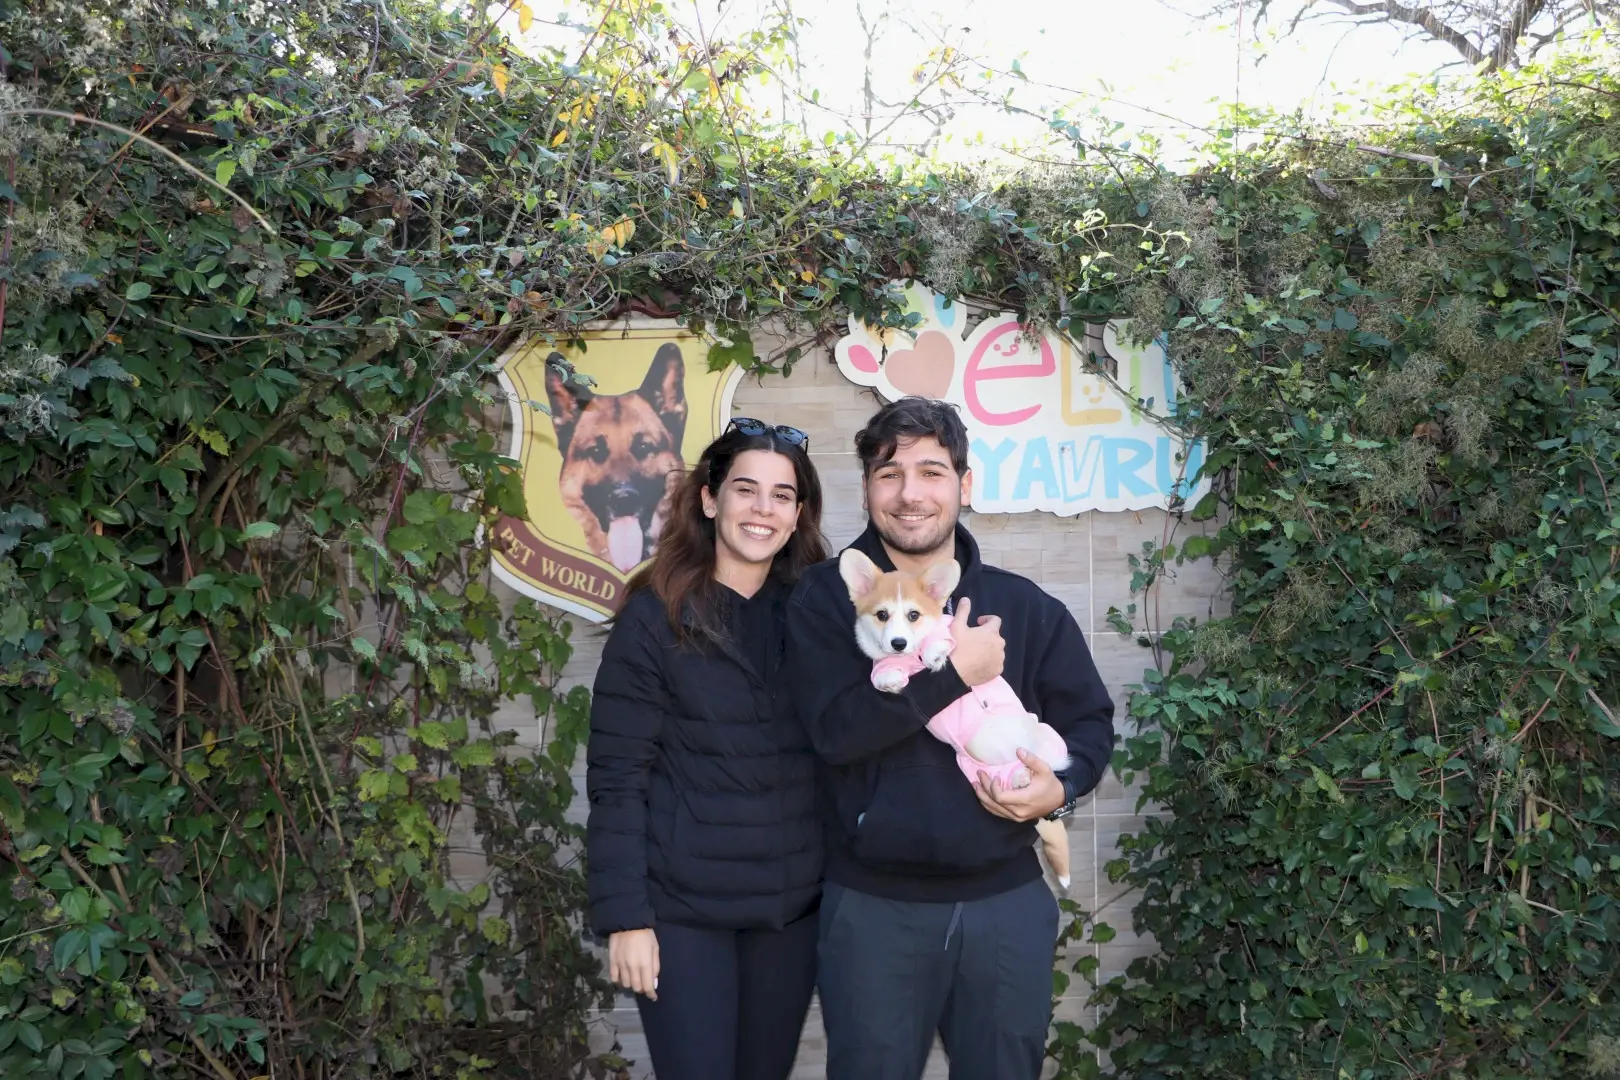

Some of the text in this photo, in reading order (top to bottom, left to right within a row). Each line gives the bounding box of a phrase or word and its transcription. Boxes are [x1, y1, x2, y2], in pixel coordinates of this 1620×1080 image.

[971, 435, 1204, 502] YAVRU
[500, 526, 616, 601] PET WORLD
